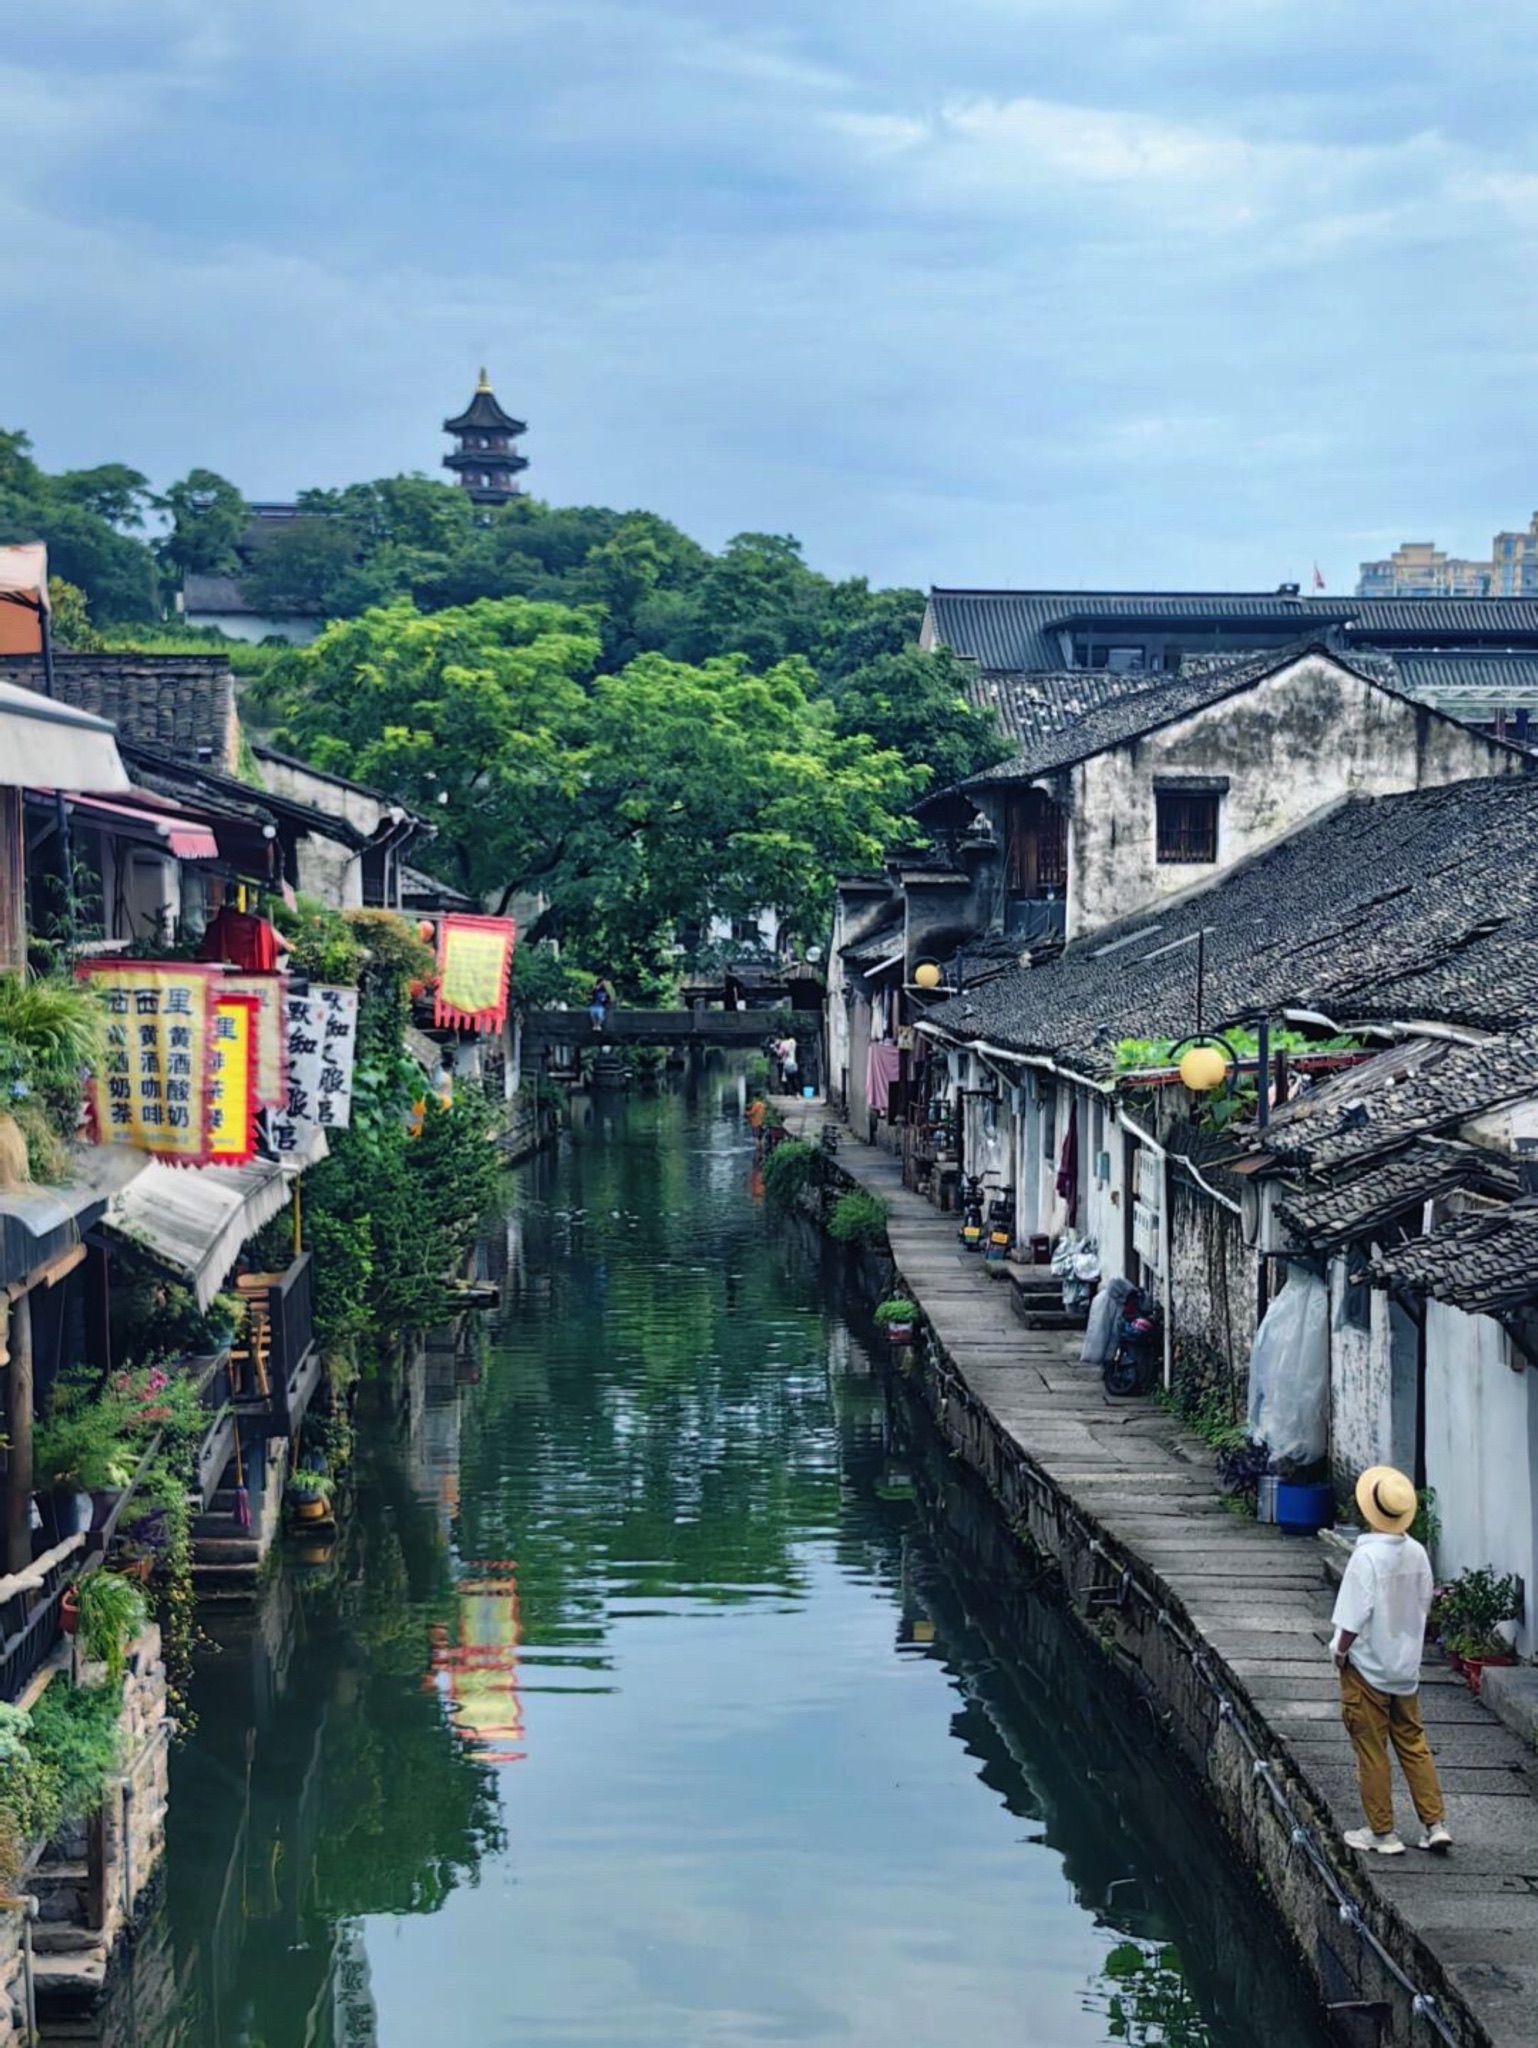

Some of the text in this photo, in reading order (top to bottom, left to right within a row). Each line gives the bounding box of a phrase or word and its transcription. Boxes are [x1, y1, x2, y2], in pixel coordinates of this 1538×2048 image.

[140, 1024, 164, 1125] 黄酒咖啡
[166, 1026, 190, 1128] 黄酒酸奶
